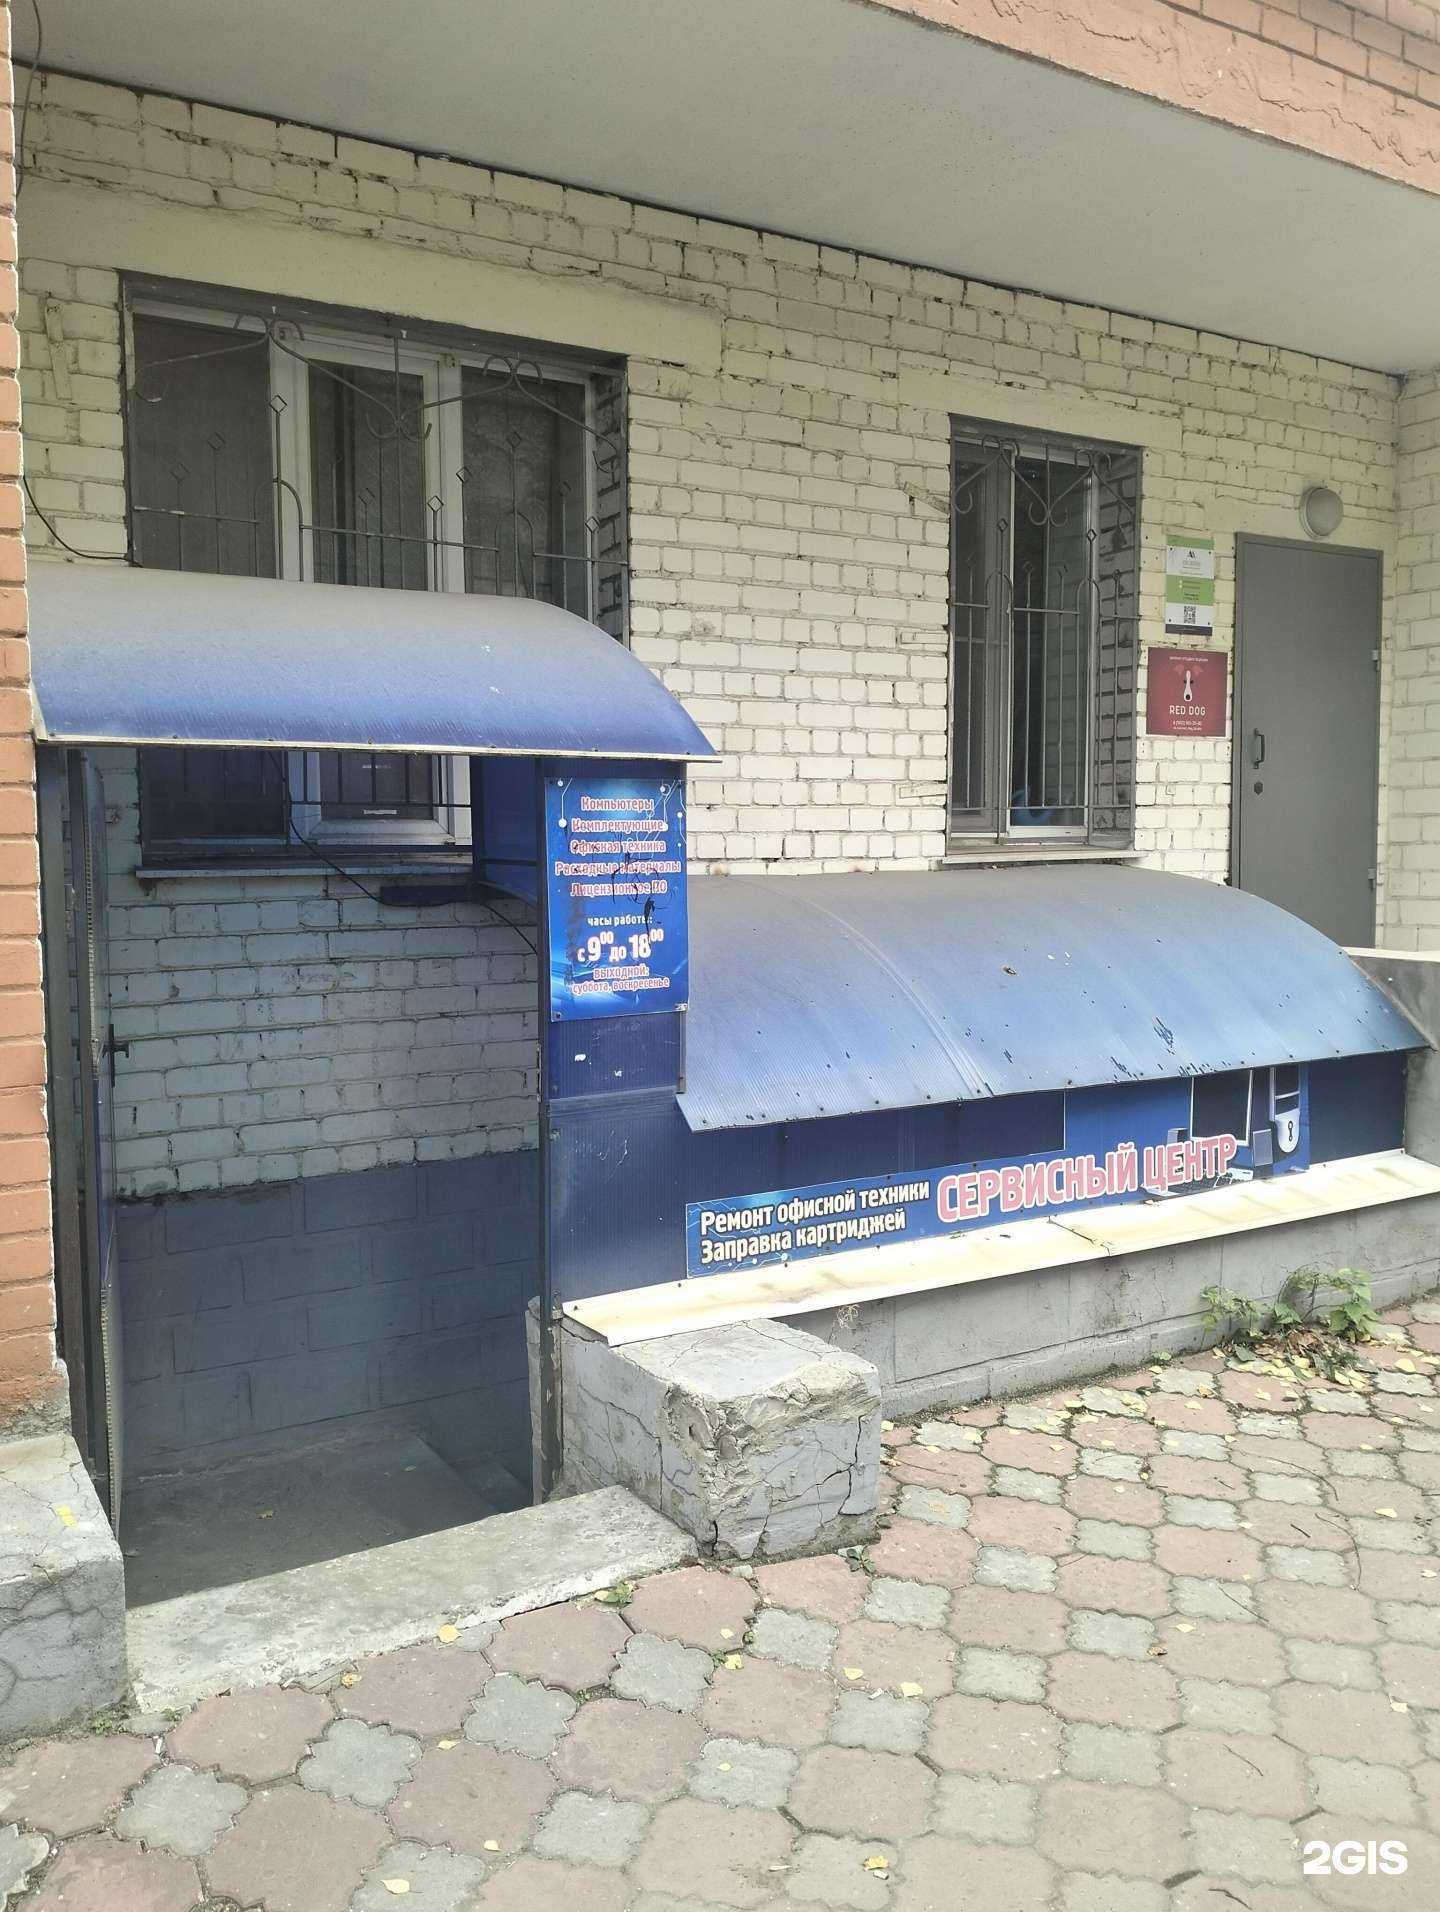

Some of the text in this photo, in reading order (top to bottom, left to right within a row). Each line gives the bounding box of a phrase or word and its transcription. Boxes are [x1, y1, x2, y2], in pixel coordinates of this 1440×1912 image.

[1169, 705, 1206, 716] RED DOG
[581, 797, 654, 812] Компьютеры
[571, 818, 664, 834] Комплектующие
[623, 840, 666, 852] техника
[555, 862, 619, 876] Расходные
[588, 917, 612, 926] часы
[609, 946, 627, 962] до
[612, 978, 670, 991] воскресенье
[937, 1134, 1237, 1222] СЕРВИСНЫЙ ЦЕНТР
[701, 1181, 930, 1236] Ремонт офисной техники
[701, 1208, 906, 1264] Заправка картриджей
